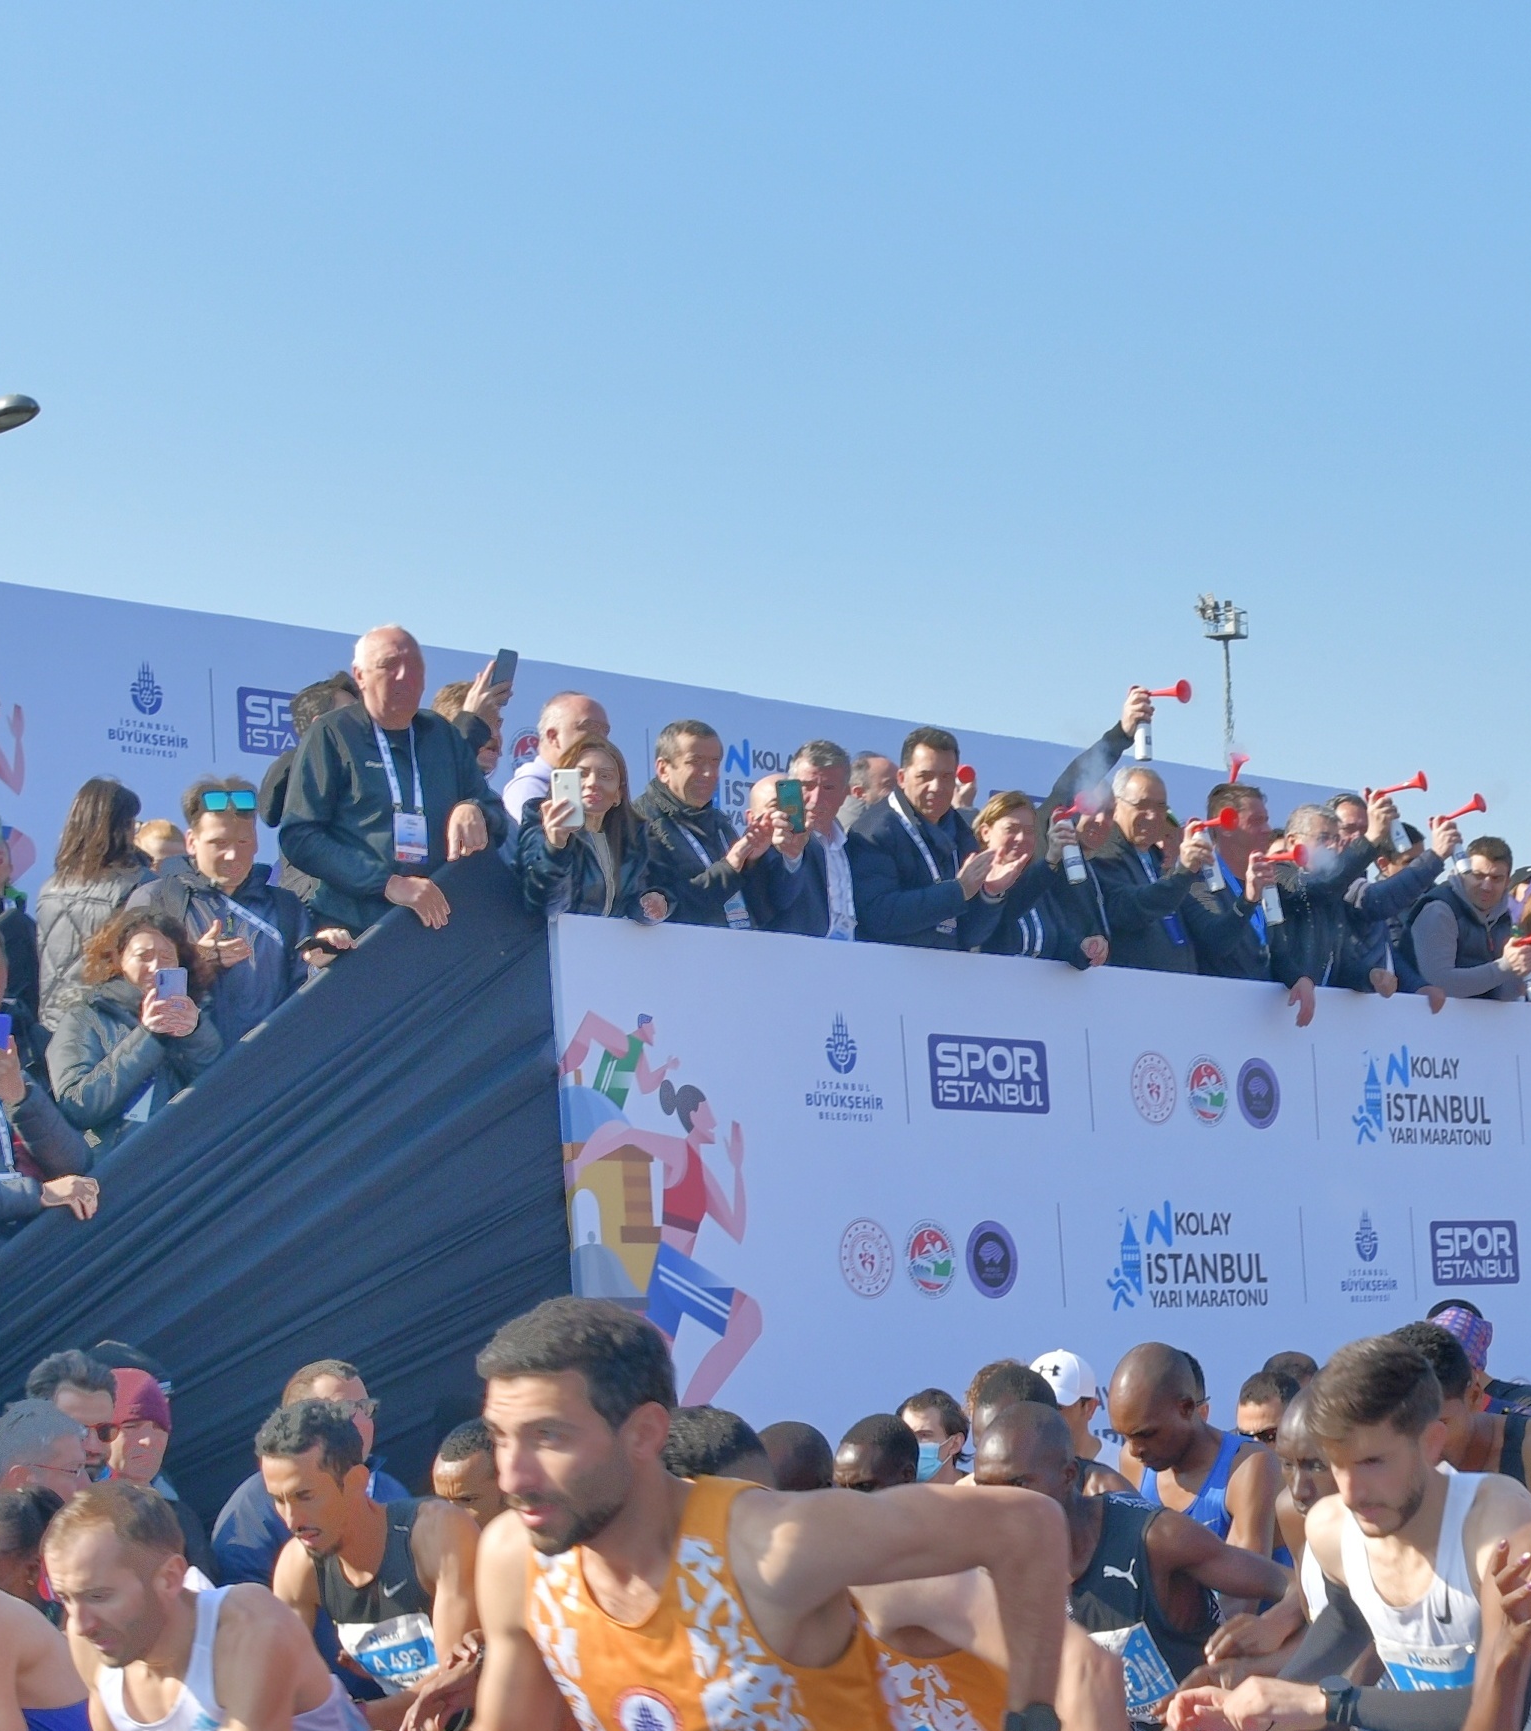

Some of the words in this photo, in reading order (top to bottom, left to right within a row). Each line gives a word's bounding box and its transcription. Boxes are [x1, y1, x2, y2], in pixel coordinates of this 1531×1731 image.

[244, 694, 292, 728] SP
[107, 728, 190, 749] BÜYÜKŞEHİR
[935, 1041, 1042, 1082] SPOR
[1410, 1055, 1461, 1081] KOLAY
[805, 1091, 885, 1111] BÜYÜKŞEHİR
[1388, 1126, 1418, 1146] YARI
[1420, 1128, 1493, 1147] MARATONU
[1174, 1211, 1233, 1237] KOLAY
[1434, 1225, 1515, 1259] SPOR
[1149, 1288, 1183, 1308] YARI
[1185, 1288, 1269, 1308] MARATONU
[390, 1648, 427, 1670] 493
